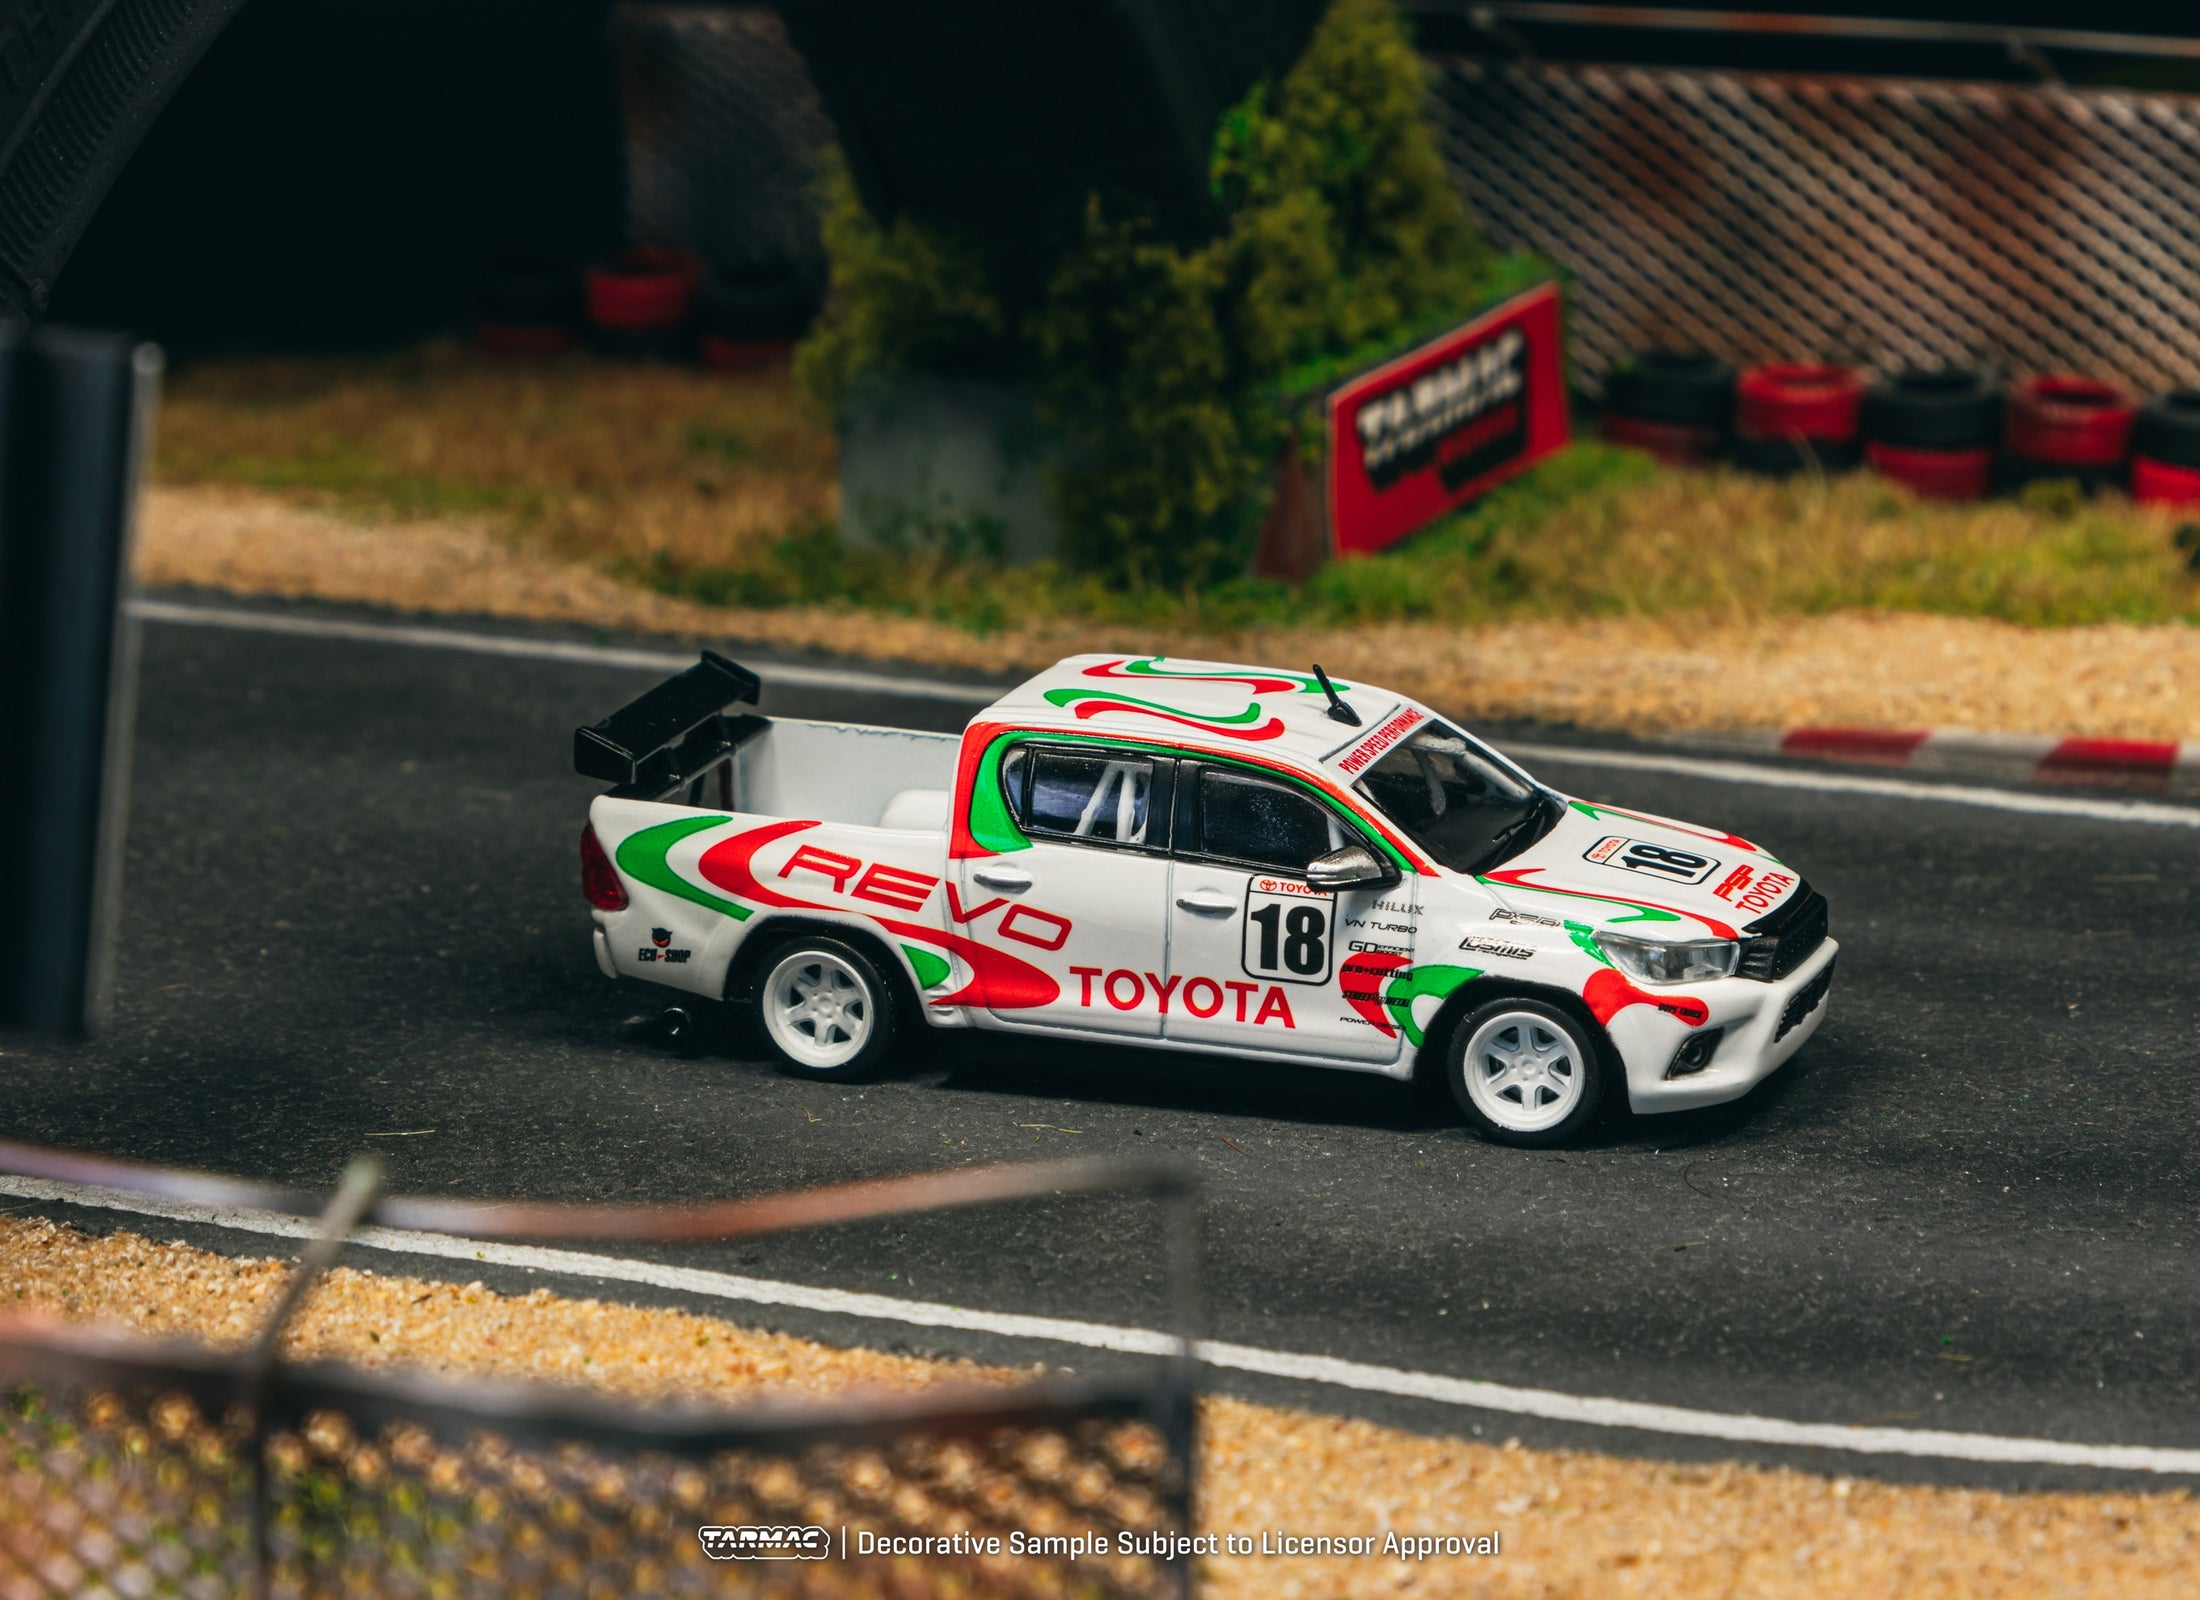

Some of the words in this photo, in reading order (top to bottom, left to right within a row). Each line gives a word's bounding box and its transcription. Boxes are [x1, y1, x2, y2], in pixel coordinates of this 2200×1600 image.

[1338, 749, 1373, 775] POWER
[1360, 734, 1390, 757] SPEED
[1378, 707, 1425, 743] PERFORMANCE
[1621, 844, 1708, 878] 18
[777, 844, 1072, 951] REVO
[1713, 864, 1754, 902] PSP
[1735, 872, 1796, 914] TOYOTA
[1345, 918, 1366, 928] VN
[1370, 921, 1418, 934] TURBO
[1372, 900, 1425, 916] HILUX
[1250, 903, 1326, 976] 18
[1348, 940, 1379, 954] GD
[1069, 965, 1296, 1029] TOYOTA
